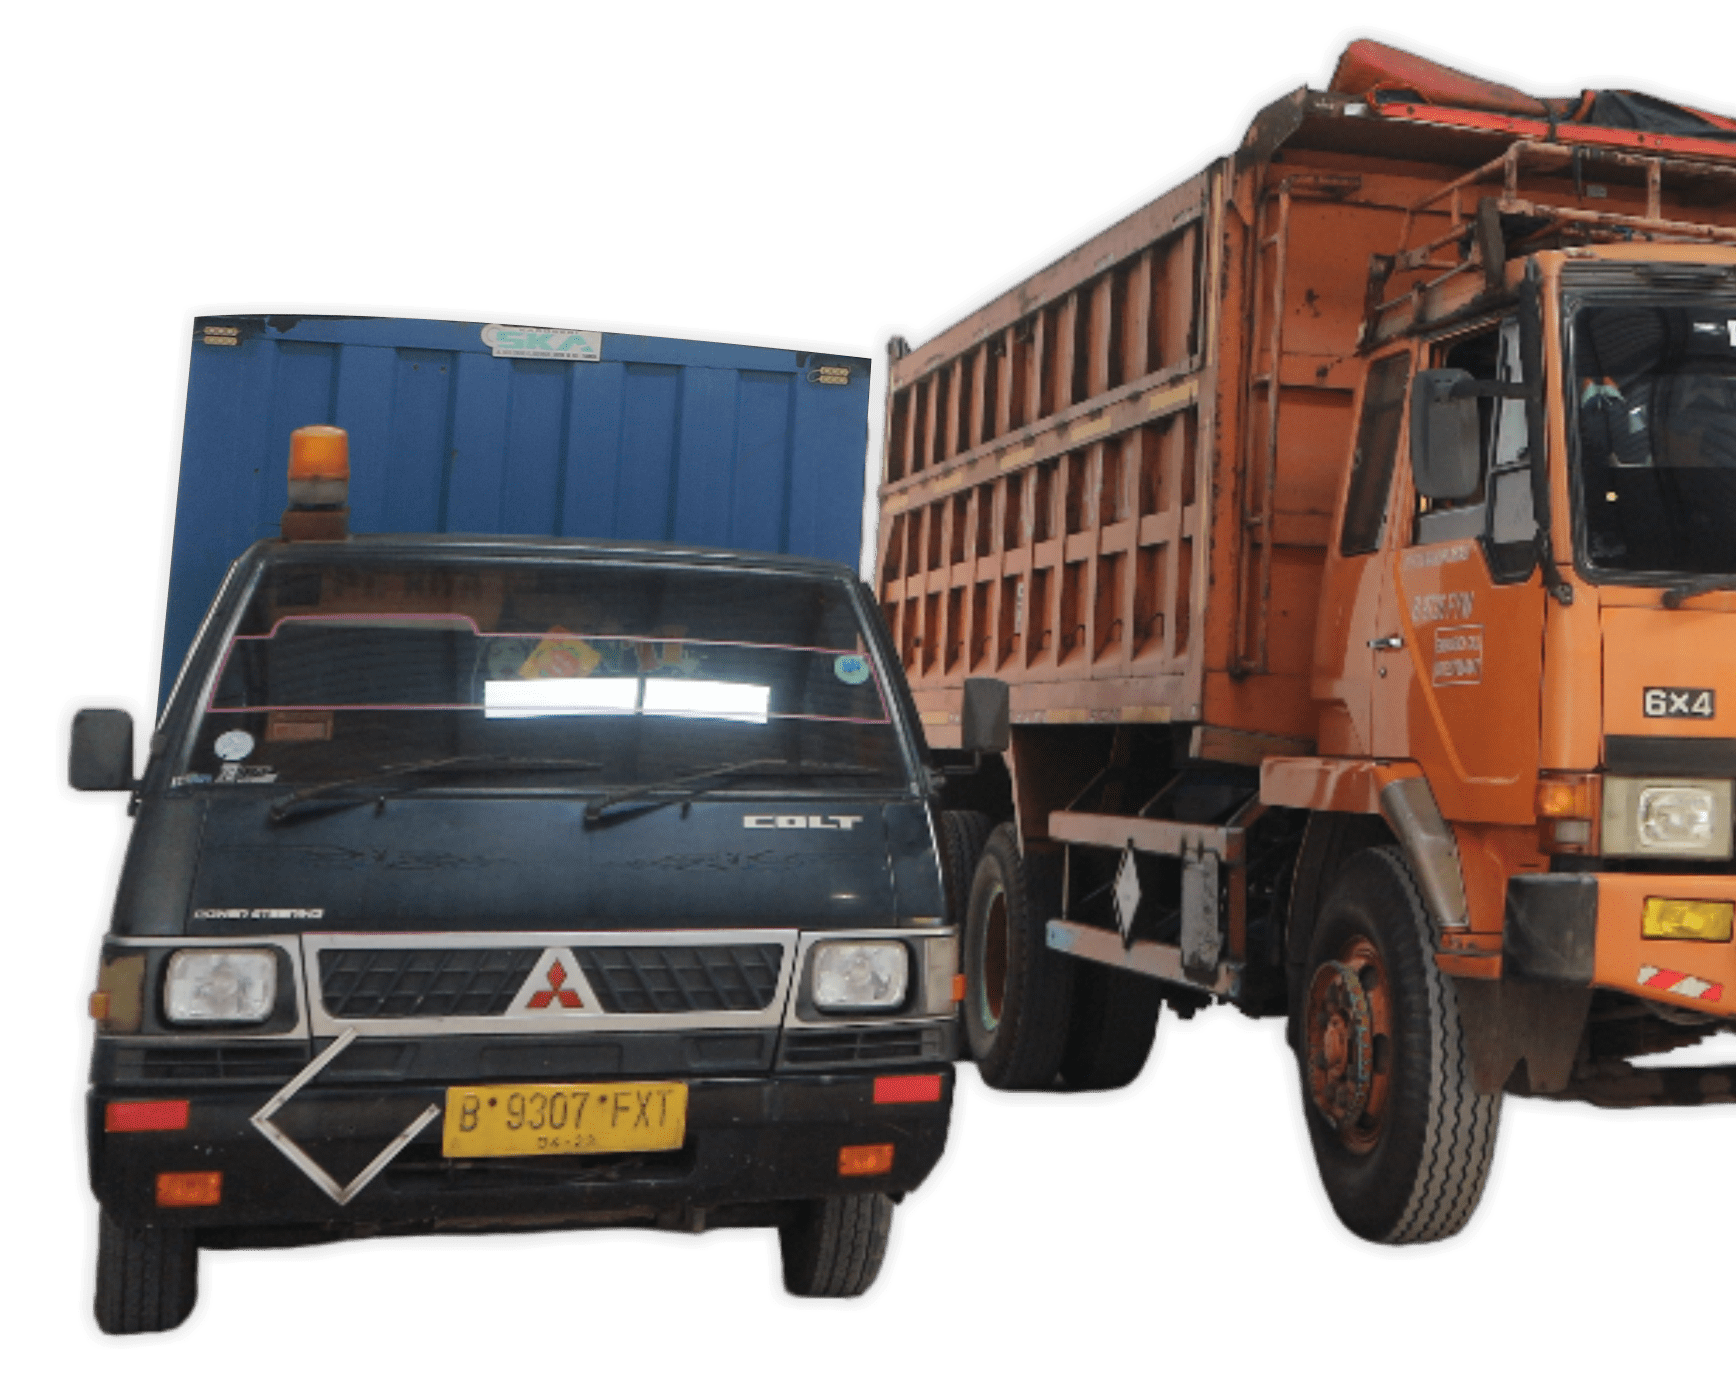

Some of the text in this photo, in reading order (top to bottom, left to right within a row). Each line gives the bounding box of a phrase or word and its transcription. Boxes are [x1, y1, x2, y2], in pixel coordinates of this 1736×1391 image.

[496, 331, 594, 353] SKA
[743, 815, 864, 831] COLT
[458, 1088, 676, 1133] B 9307 FXT
